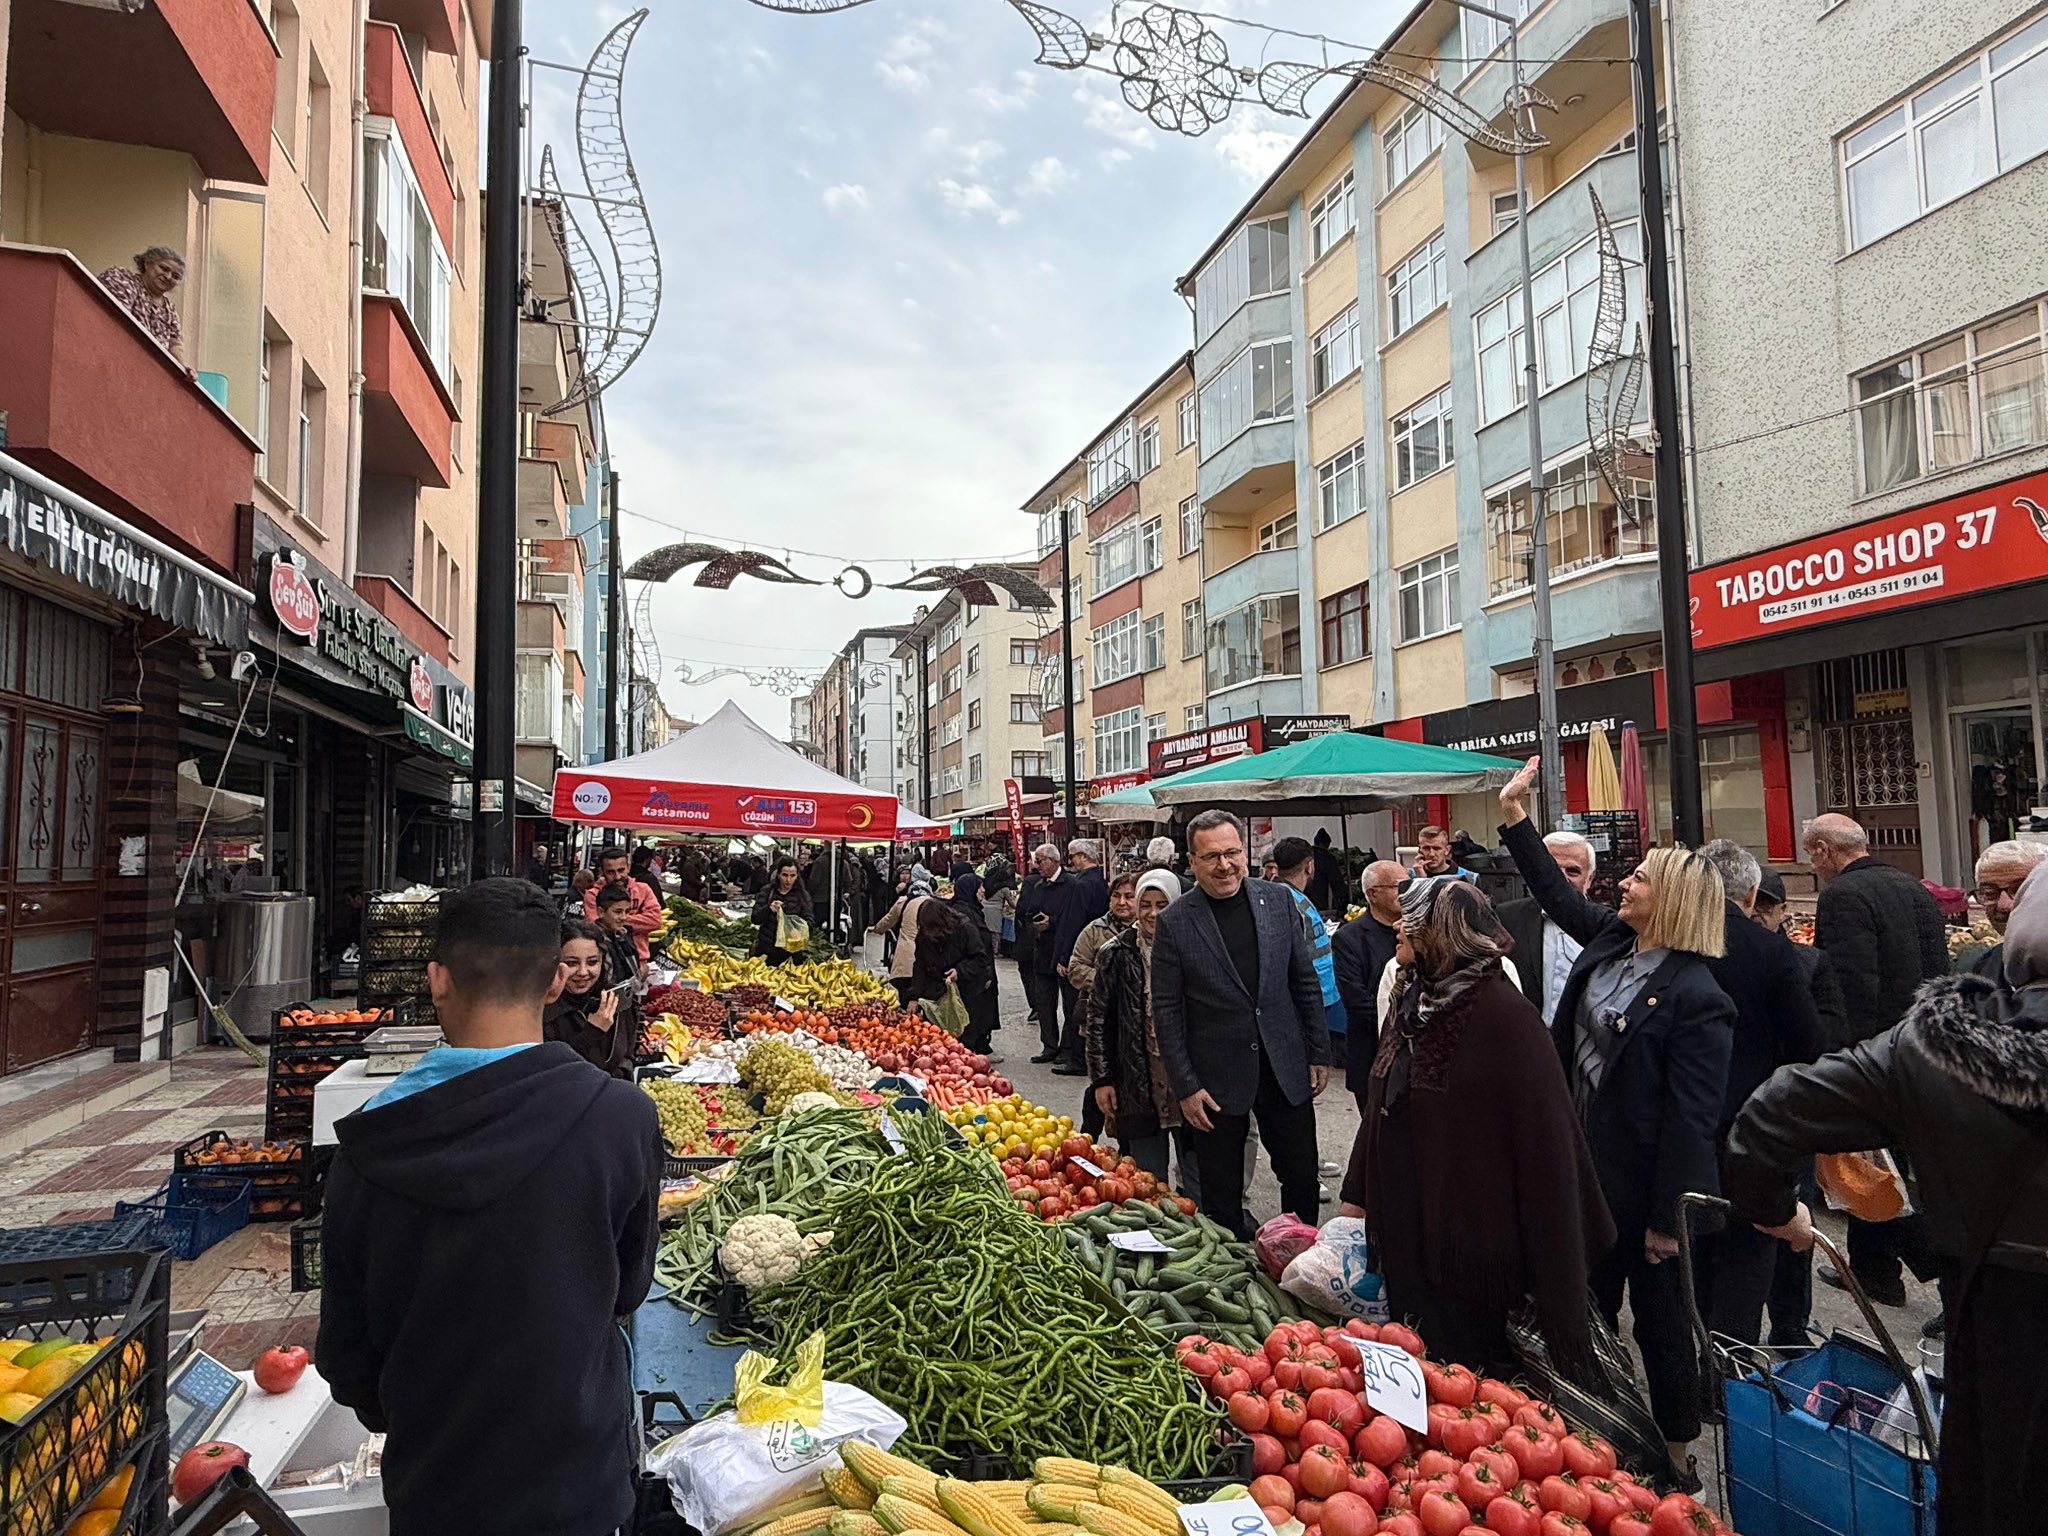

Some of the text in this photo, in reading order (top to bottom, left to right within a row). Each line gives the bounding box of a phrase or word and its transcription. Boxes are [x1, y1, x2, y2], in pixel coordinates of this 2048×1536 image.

[1715, 505, 1997, 608] TABOCCO SHOP 37
[1762, 605, 1788, 619] 0542
[1790, 601, 1807, 613] 511
[1810, 598, 1823, 609] 91
[1827, 593, 1840, 604] 14
[1848, 585, 1877, 601] 0543
[1880, 581, 1899, 594] 511
[1903, 577, 1919, 589] 91
[1922, 571, 1939, 585] 04
[1210, 724, 1248, 746] AMBALAJ
[1540, 718, 1616, 746] ĞAZSI
[574, 794, 608, 804] NO: 76
[788, 800, 814, 814] 153
[641, 806, 710, 820] Kastamonu
[744, 810, 775, 823] ÇÖZÜM
